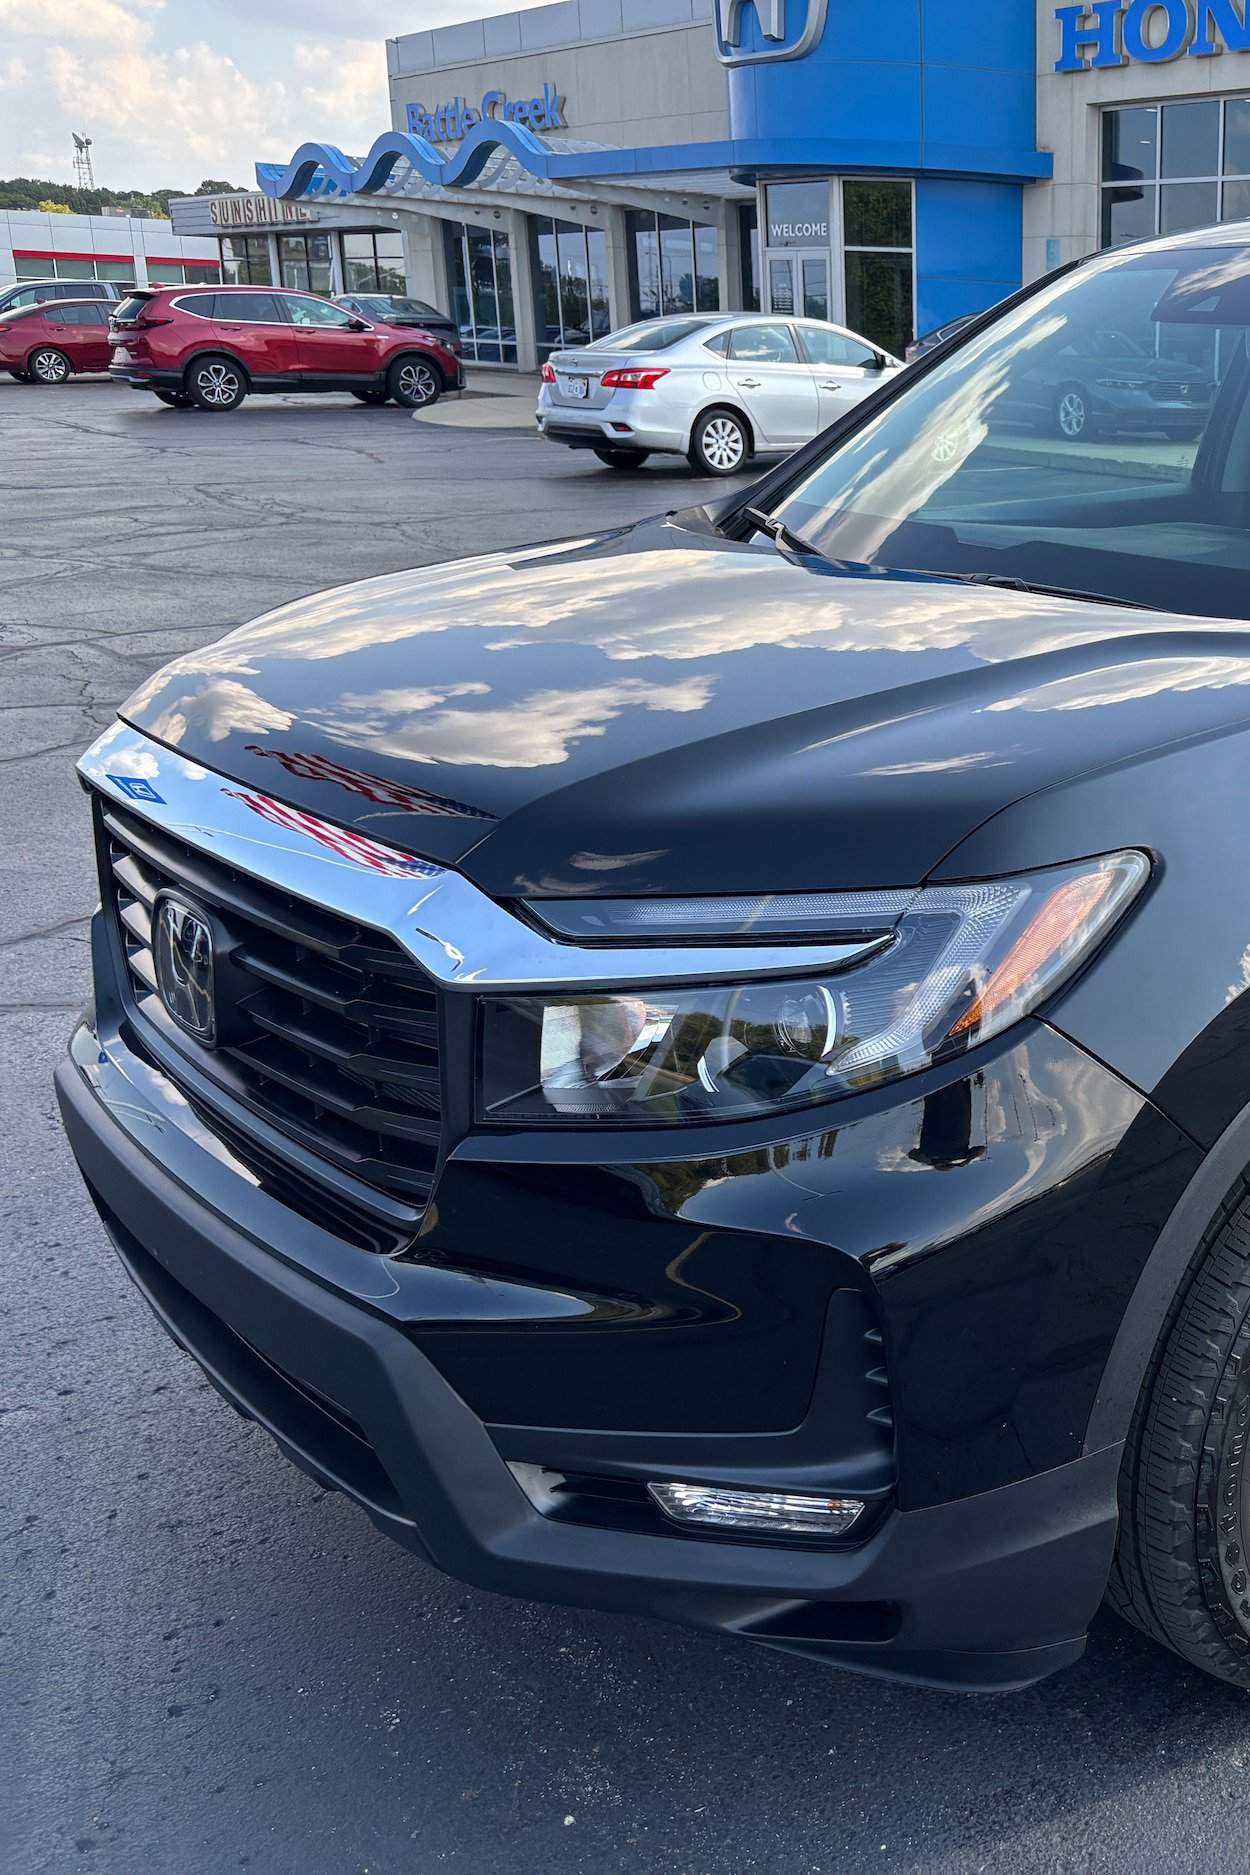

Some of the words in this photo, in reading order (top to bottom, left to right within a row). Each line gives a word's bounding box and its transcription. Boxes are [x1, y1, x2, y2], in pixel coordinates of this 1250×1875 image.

[406, 97, 478, 142] Battle
[482, 80, 564, 130] Creek
[771, 222, 828, 237] WELCOME
